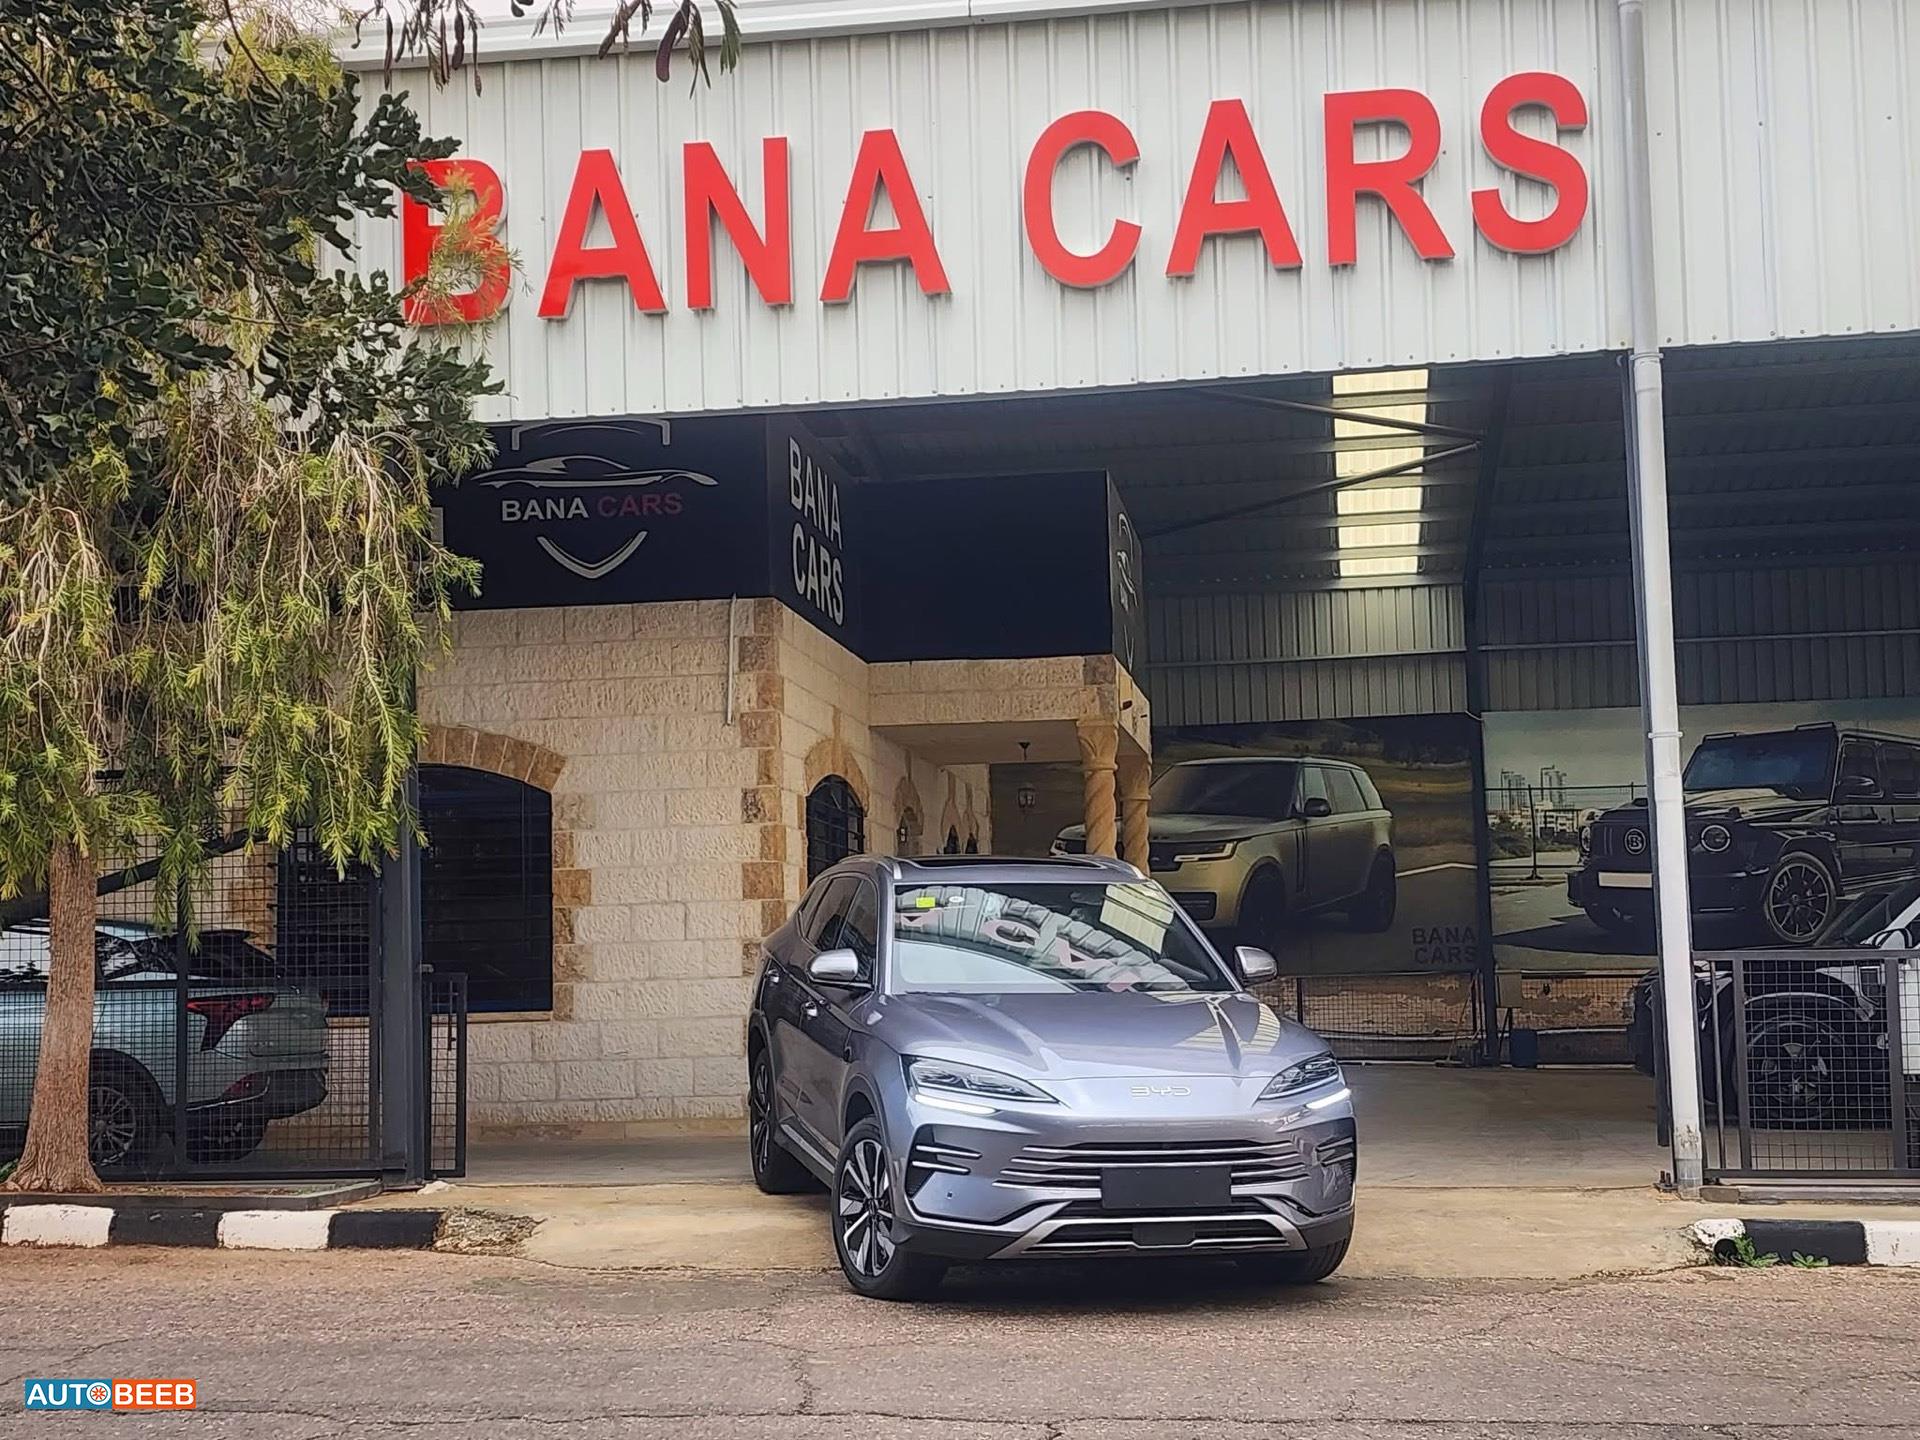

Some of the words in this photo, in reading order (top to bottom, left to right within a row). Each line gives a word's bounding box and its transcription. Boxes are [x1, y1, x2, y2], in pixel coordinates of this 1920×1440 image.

[402, 128, 951, 327] BANA
[1022, 71, 1589, 290] CARS
[501, 497, 589, 521] BANA
[597, 492, 683, 517] CARS
[789, 437, 842, 550] BANA
[792, 522, 843, 626] CARS
[1412, 926, 1476, 945] BANA
[1414, 946, 1478, 964] CARS
[1130, 1086, 1192, 1097] BYD
